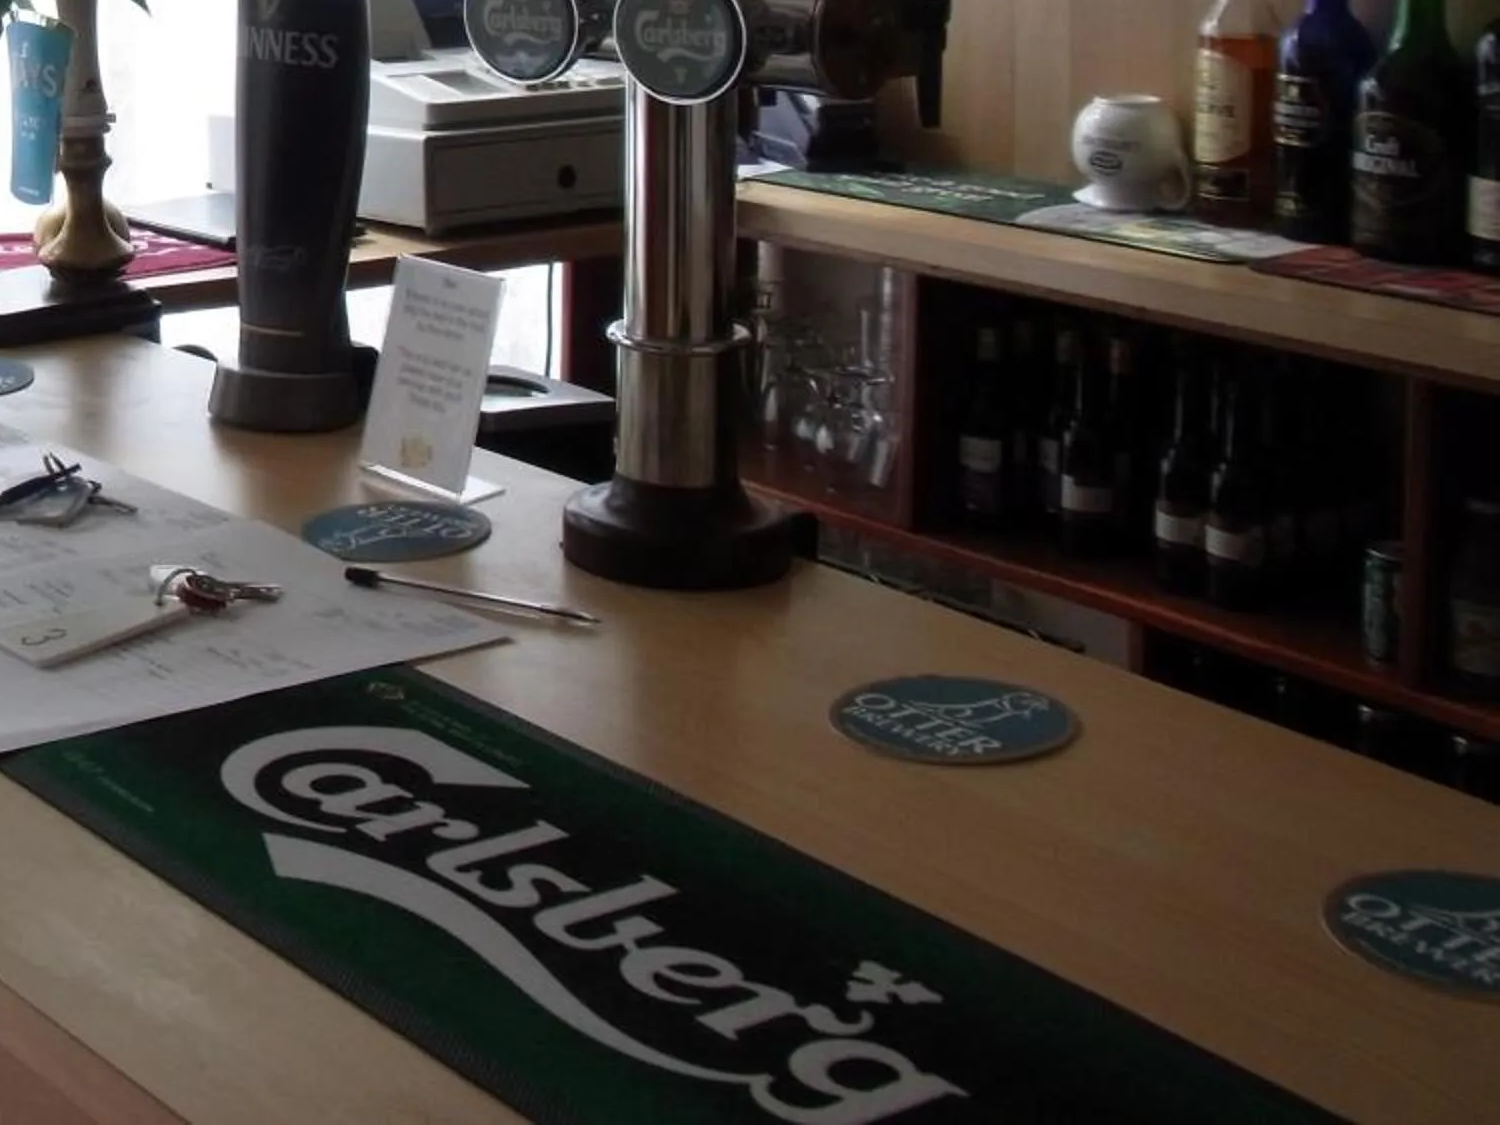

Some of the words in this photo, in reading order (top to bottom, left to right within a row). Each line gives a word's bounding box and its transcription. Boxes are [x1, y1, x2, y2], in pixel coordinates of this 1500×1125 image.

[635, 9, 728, 62] Carlsberg
[853, 692, 1003, 755] OTTER
[220, 725, 970, 1125] Carlsberg
